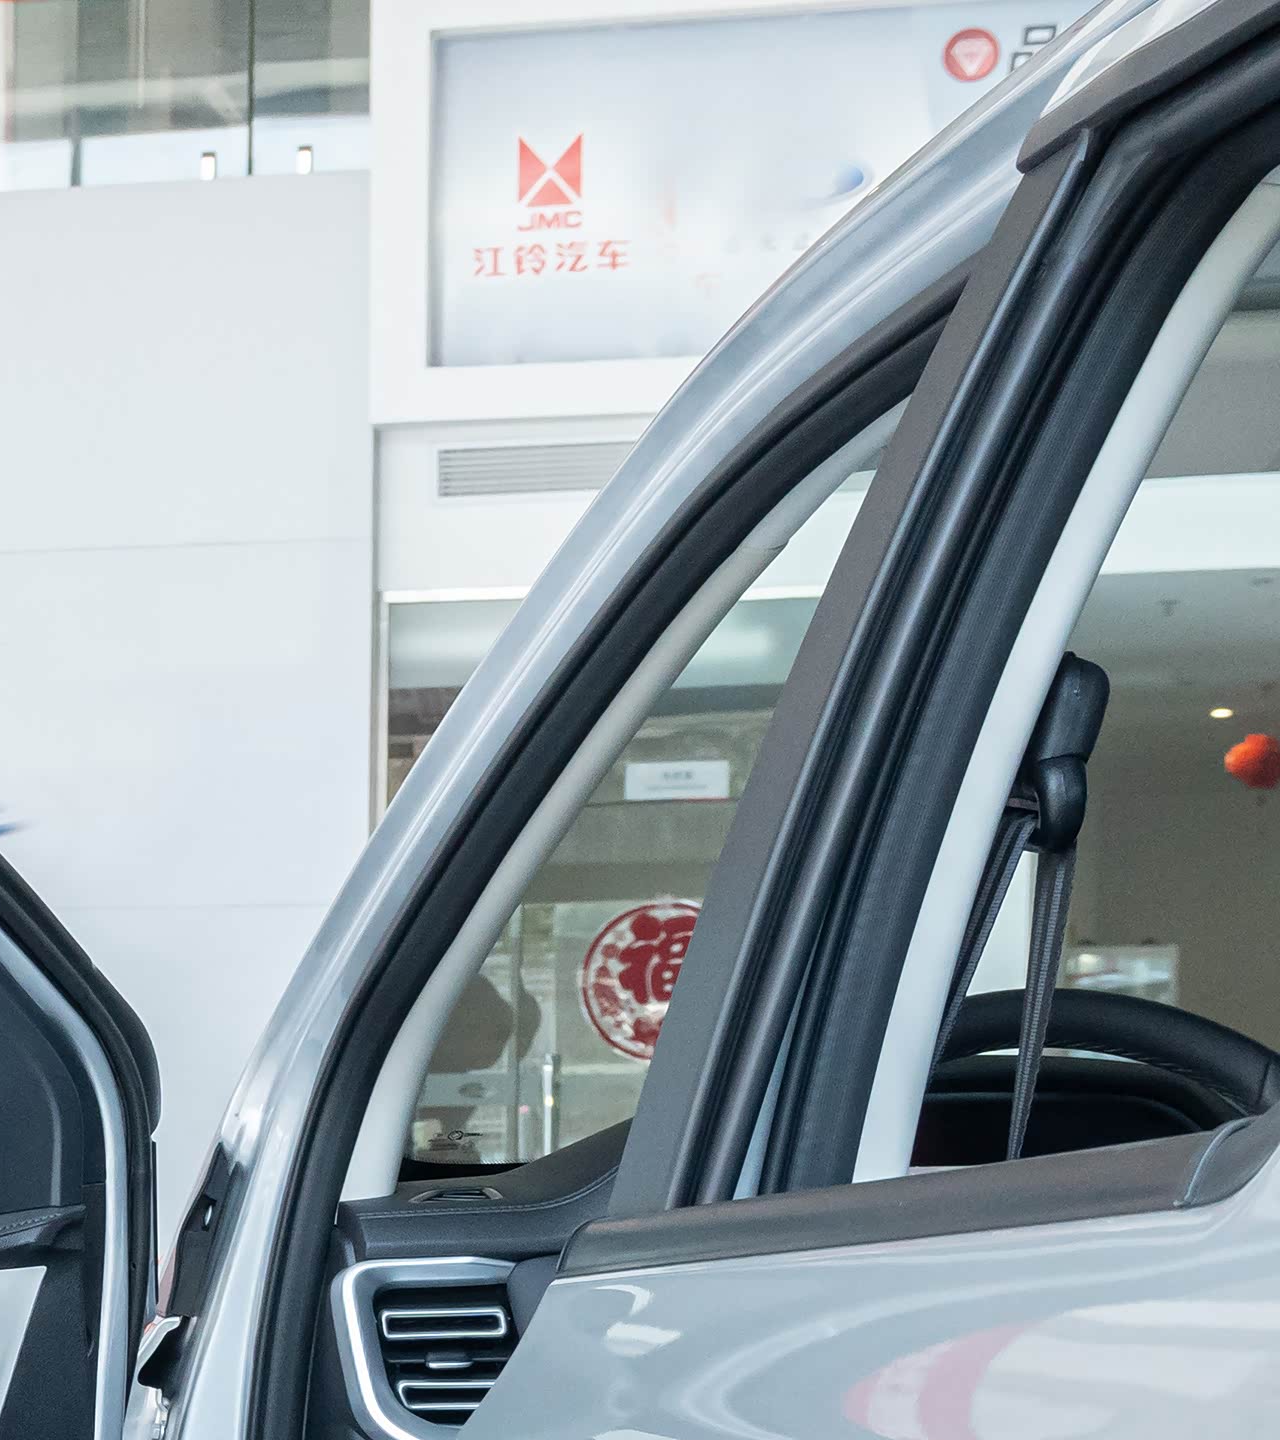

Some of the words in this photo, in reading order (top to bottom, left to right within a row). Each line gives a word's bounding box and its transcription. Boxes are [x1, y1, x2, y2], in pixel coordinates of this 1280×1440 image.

[516, 210, 583, 232] JMC
[472, 239, 631, 277] 江铃汽车
